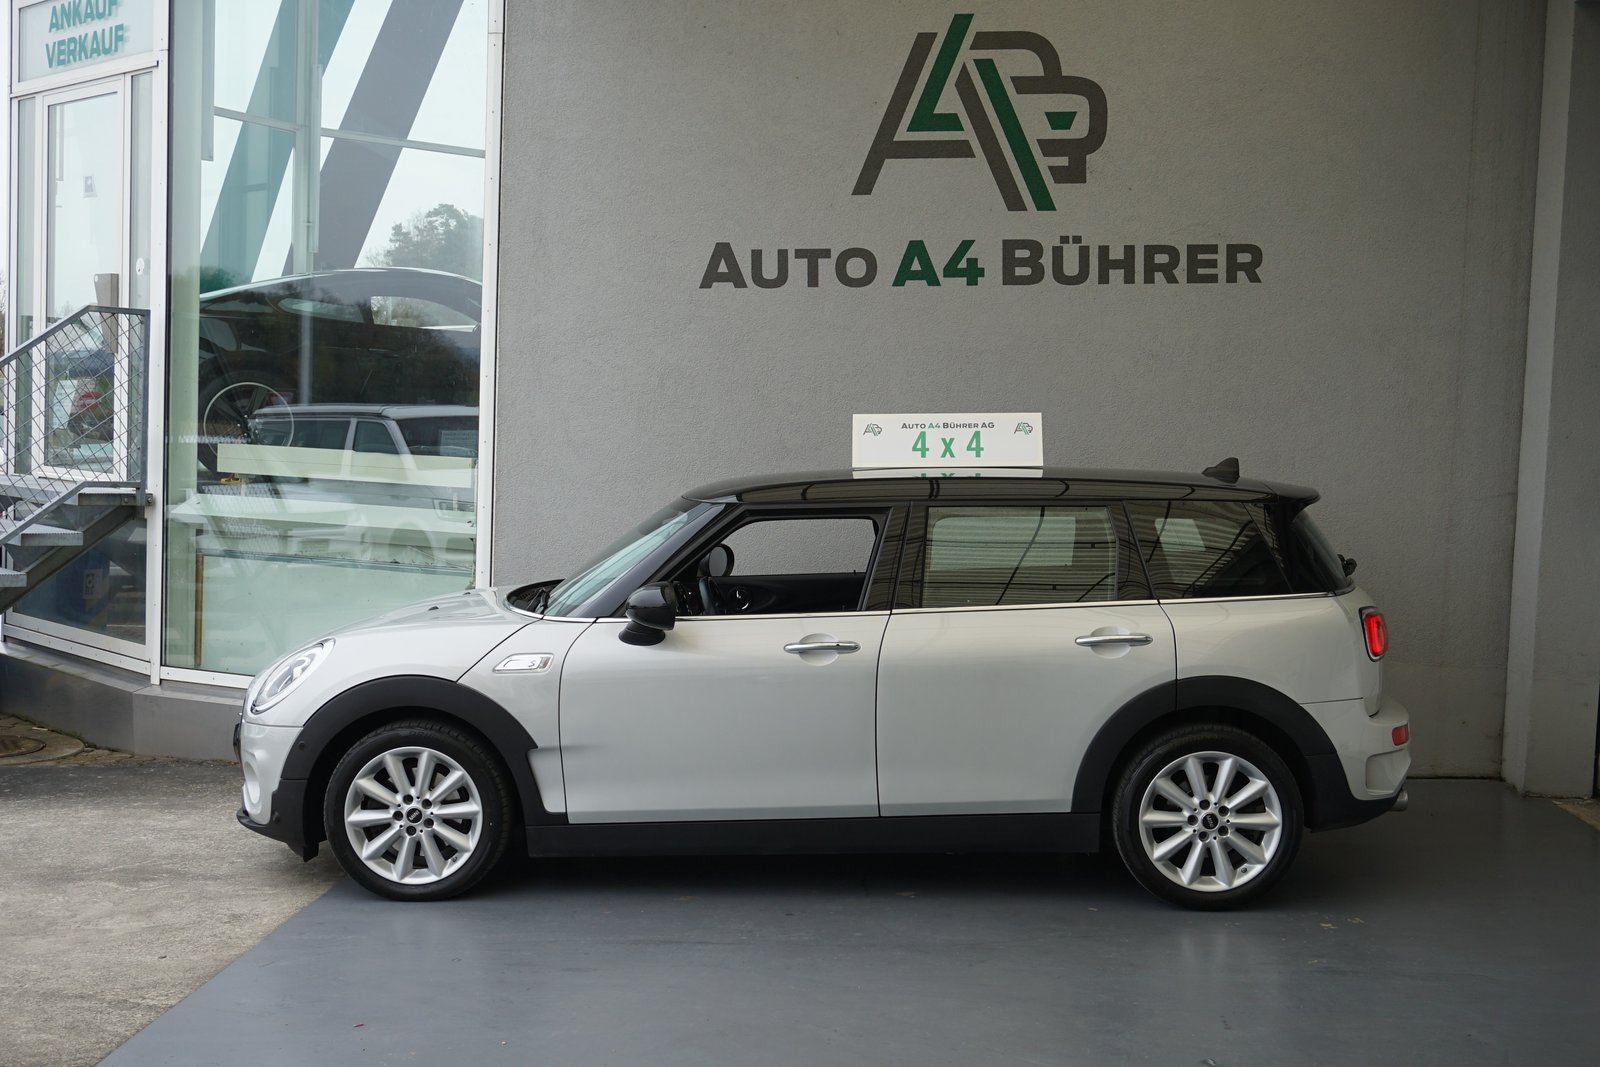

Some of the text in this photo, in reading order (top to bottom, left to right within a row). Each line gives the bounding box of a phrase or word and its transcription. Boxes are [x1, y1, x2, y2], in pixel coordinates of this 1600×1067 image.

[49, 0, 117, 33] ANKAUF
[45, 24, 124, 68] VERKAUF
[699, 235, 1263, 288] AUTO A4 BÜHRER
[901, 422, 926, 430] AUTO
[942, 421, 979, 429] BÜHRER
[981, 421, 995, 429] AG
[911, 431, 929, 458] 4
[966, 431, 984, 458] 4
